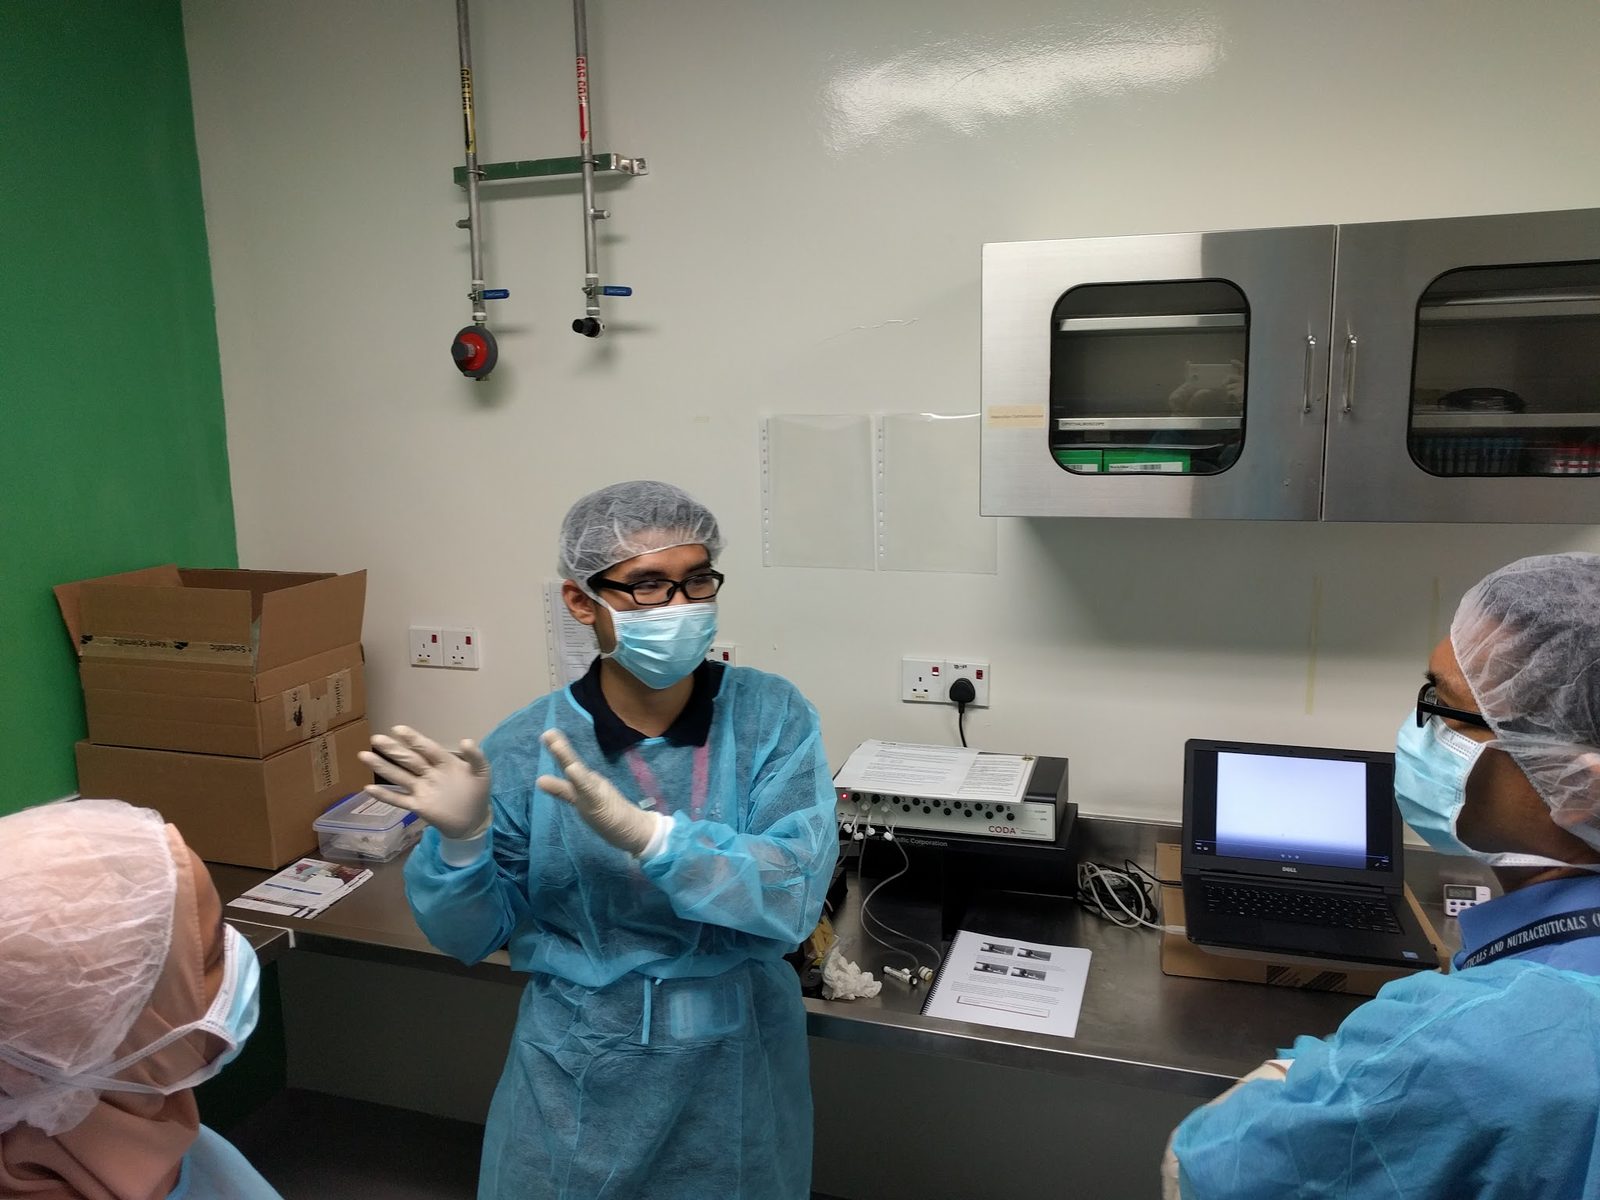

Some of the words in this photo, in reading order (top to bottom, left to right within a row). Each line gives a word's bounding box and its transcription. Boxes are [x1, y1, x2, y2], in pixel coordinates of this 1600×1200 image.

[576, 57, 585, 78] GAS
[460, 69, 470, 89] GAS
[112, 638, 148, 647] Scientific
[209, 643, 247, 653] Scientific
[988, 825, 1017, 835] CODA
[910, 837, 949, 847] Corporation
[1488, 941, 1504, 957] AND
[1506, 915, 1588, 948] NUTRACEUTICALS
